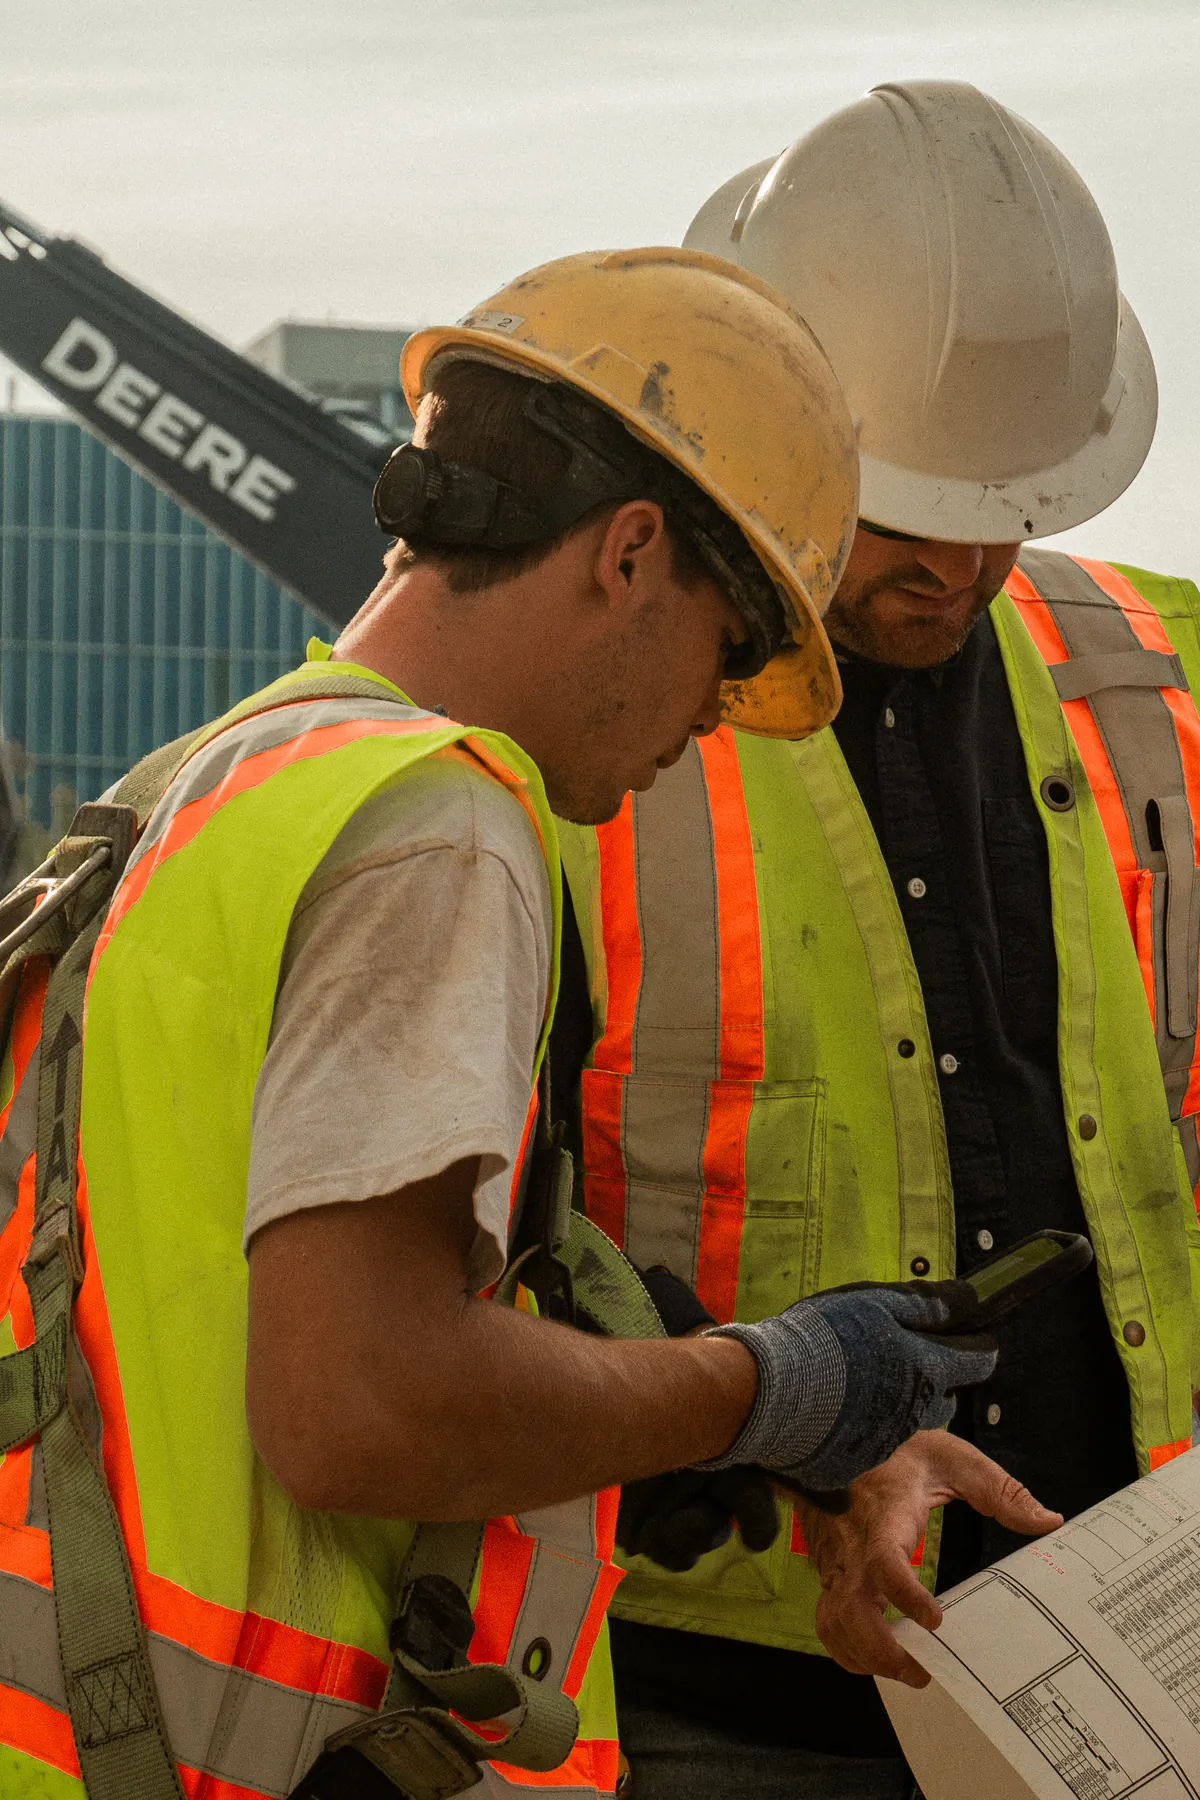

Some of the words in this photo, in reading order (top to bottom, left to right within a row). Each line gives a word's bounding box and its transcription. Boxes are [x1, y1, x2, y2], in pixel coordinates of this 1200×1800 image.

[42, 316, 296, 522] DEERE
[1143, 1534, 1154, 1545] 33
[1174, 1514, 1184, 1524] 34
[1182, 1577, 1196, 1593] Storm
[1005, 1704, 1025, 1726] Approved
[1020, 1722, 1030, 1733] by
[1024, 1692, 1039, 1708] Drawn
[1034, 1704, 1044, 1714] by
[1041, 1680, 1055, 1696] Scale
[1085, 1730, 1100, 1747] 1:500
[1108, 1760, 1121, 1774] 25m
[1011, 1700, 1030, 1721] Checked
[1025, 1717, 1035, 1727] by
[1059, 1757, 1069, 1767] CK
[1017, 1696, 1037, 1717] Designed
[1032, 1713, 1043, 1724] by
[1066, 1752, 1076, 1763] CK
[1042, 1701, 1049, 1709] 0
[1051, 1713, 1062, 1724] 0.5
[1069, 1733, 1077, 1741] V
[1095, 1767, 1110, 1782] 2.5m
